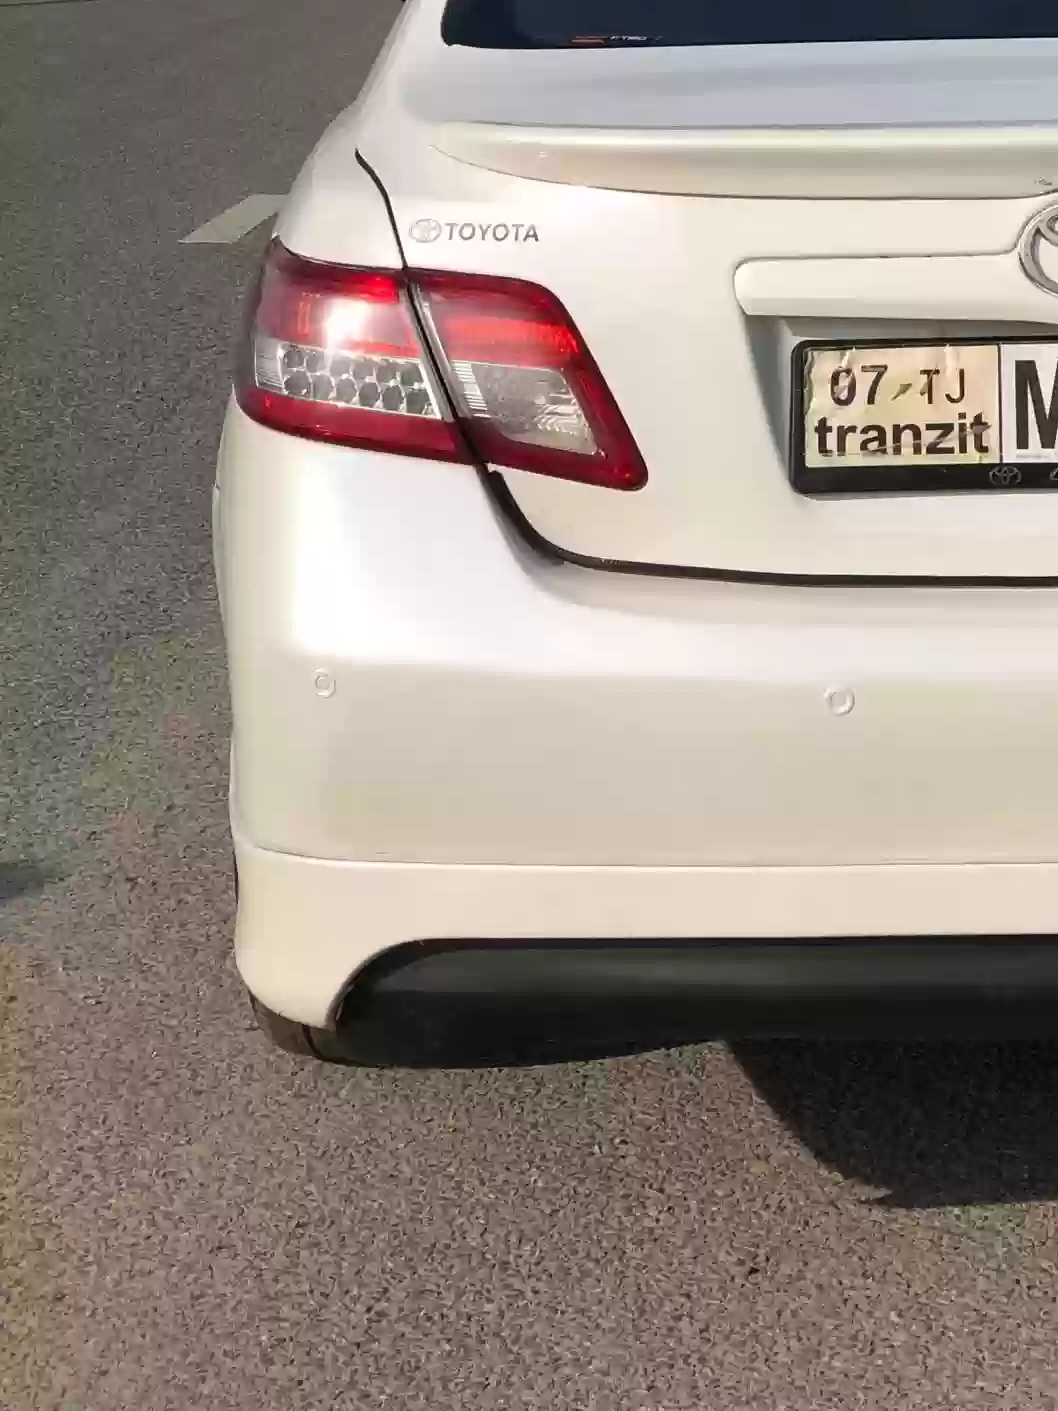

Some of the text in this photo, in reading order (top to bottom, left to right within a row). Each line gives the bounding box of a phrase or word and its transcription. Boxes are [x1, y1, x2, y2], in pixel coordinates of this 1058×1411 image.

[444, 222, 540, 242] TOYOTA
[830, 364, 888, 406] 07
[814, 412, 991, 456] tranzit
